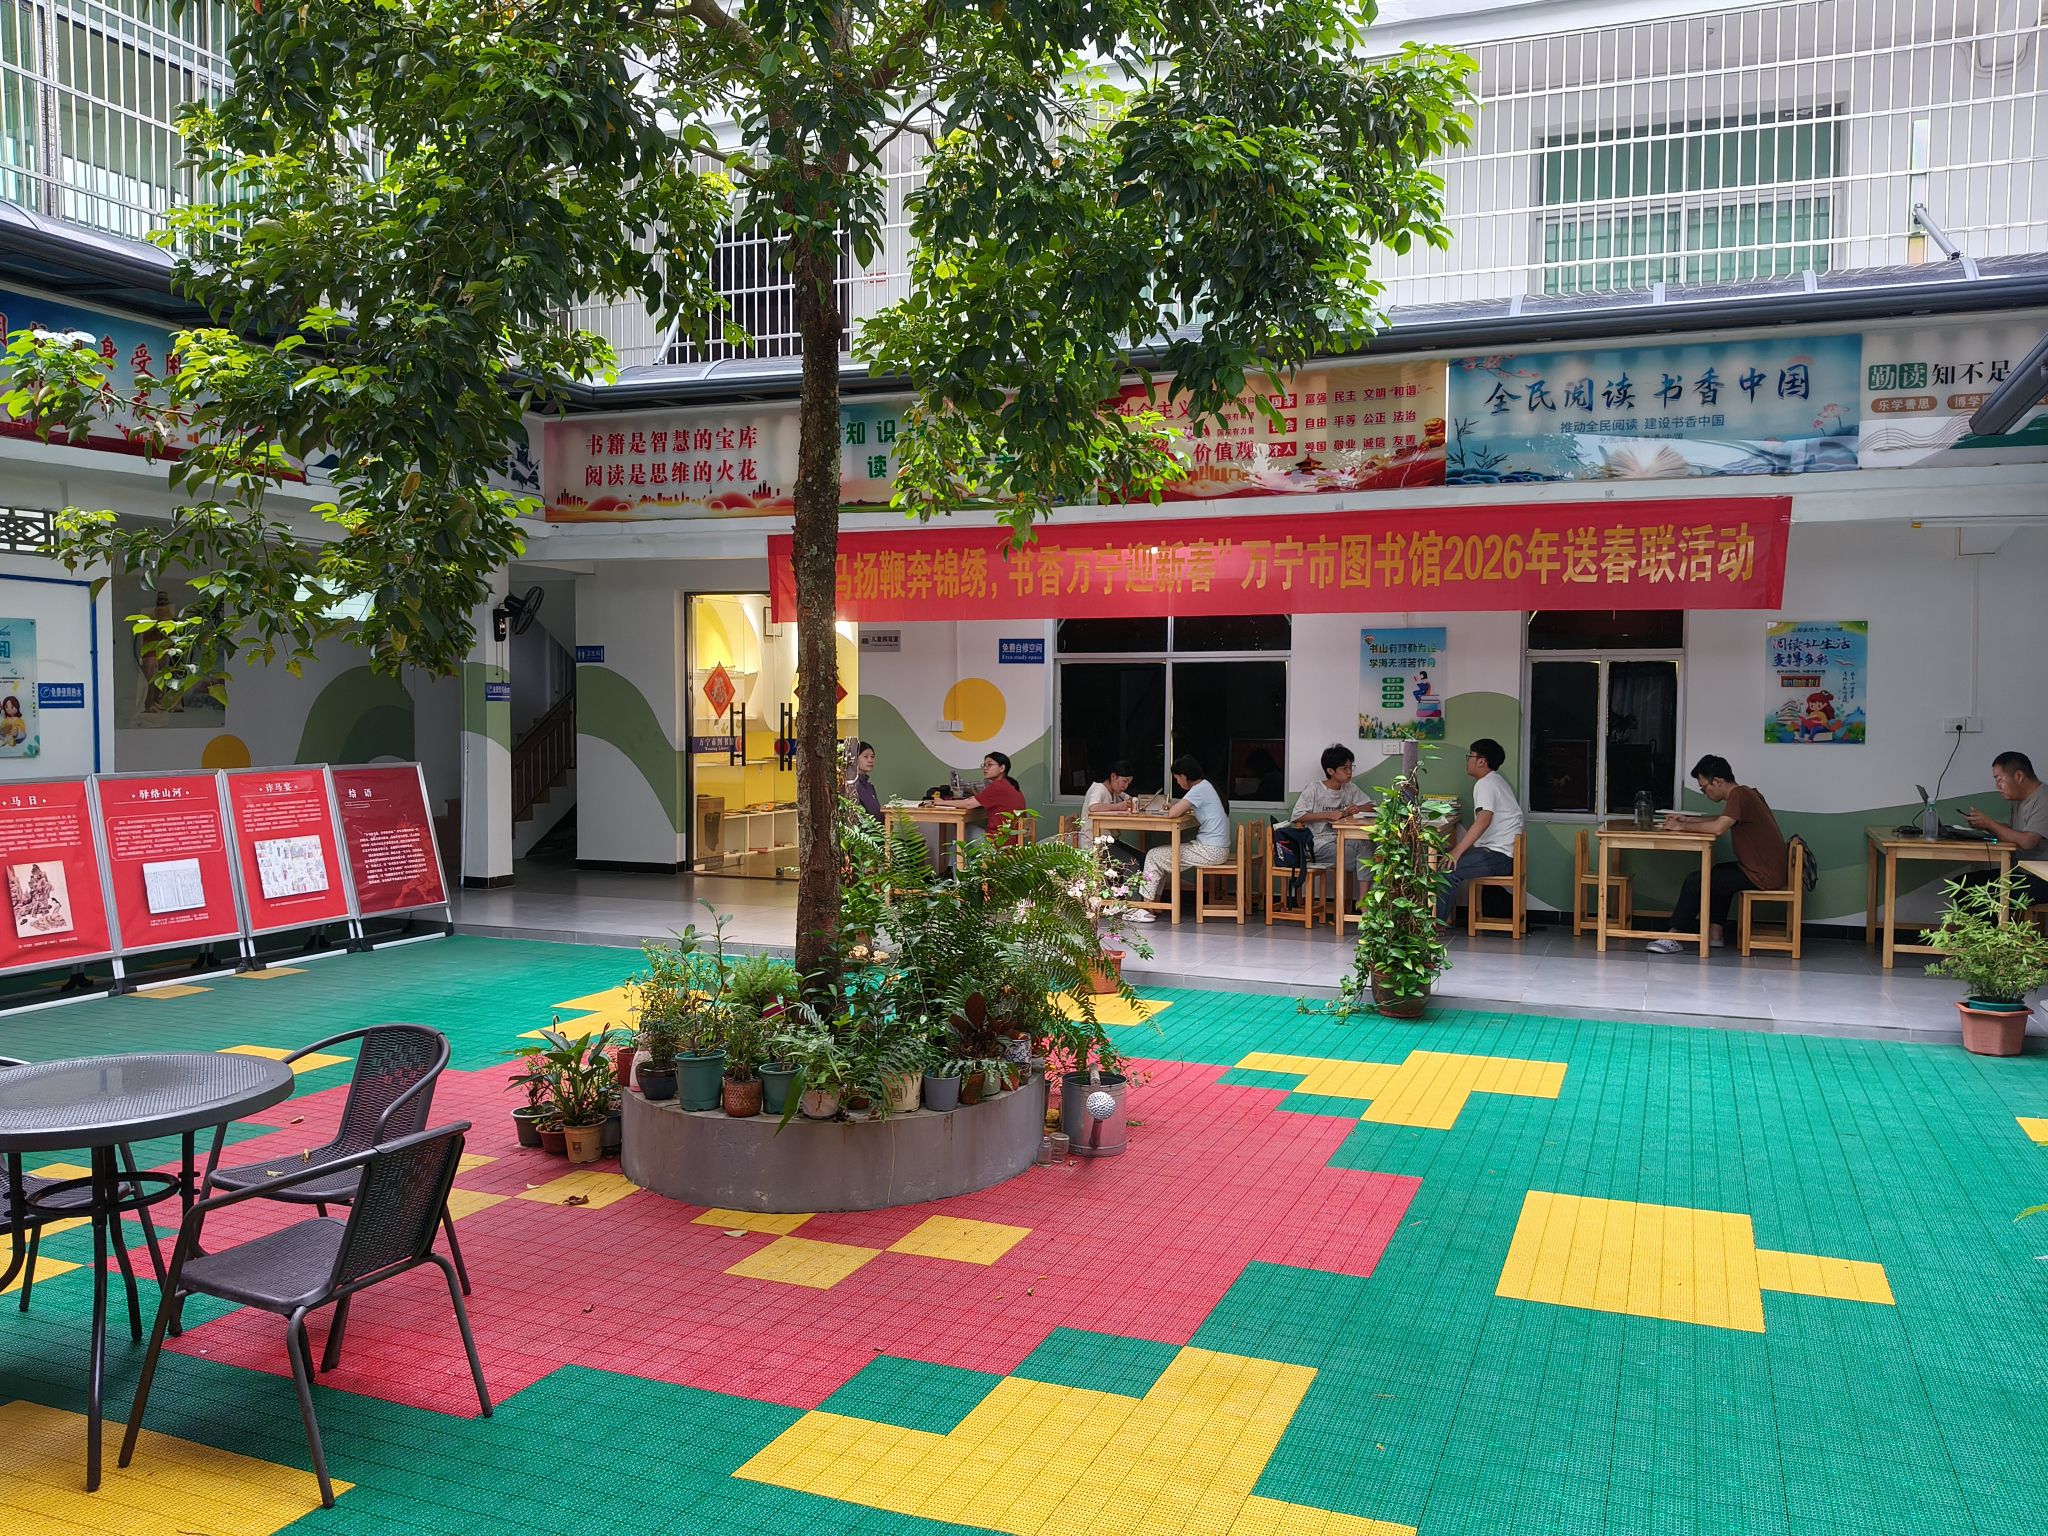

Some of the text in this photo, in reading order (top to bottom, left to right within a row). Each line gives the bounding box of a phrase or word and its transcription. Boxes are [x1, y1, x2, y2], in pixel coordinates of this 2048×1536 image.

[1334, 390, 1357, 403] 民主
[1363, 387, 1387, 401] 文明
[1485, 362, 1813, 418] 全民阅读 书香中国
[1304, 416, 1328, 431] 自由
[1334, 414, 1358, 427] 平等
[1363, 411, 1387, 425] 公正
[1393, 410, 1417, 423] 法治
[1560, 414, 1725, 434] 推动全民阅读 建设书香中国
[586, 425, 758, 457] 书籍是智慧的宝库
[1363, 436, 1387, 450] 诚信
[585, 458, 758, 487] 阅读是思维的火花
[1772, 638, 1851, 651] 阅读让生活
[1772, 652, 1829, 667] 变得多彩
